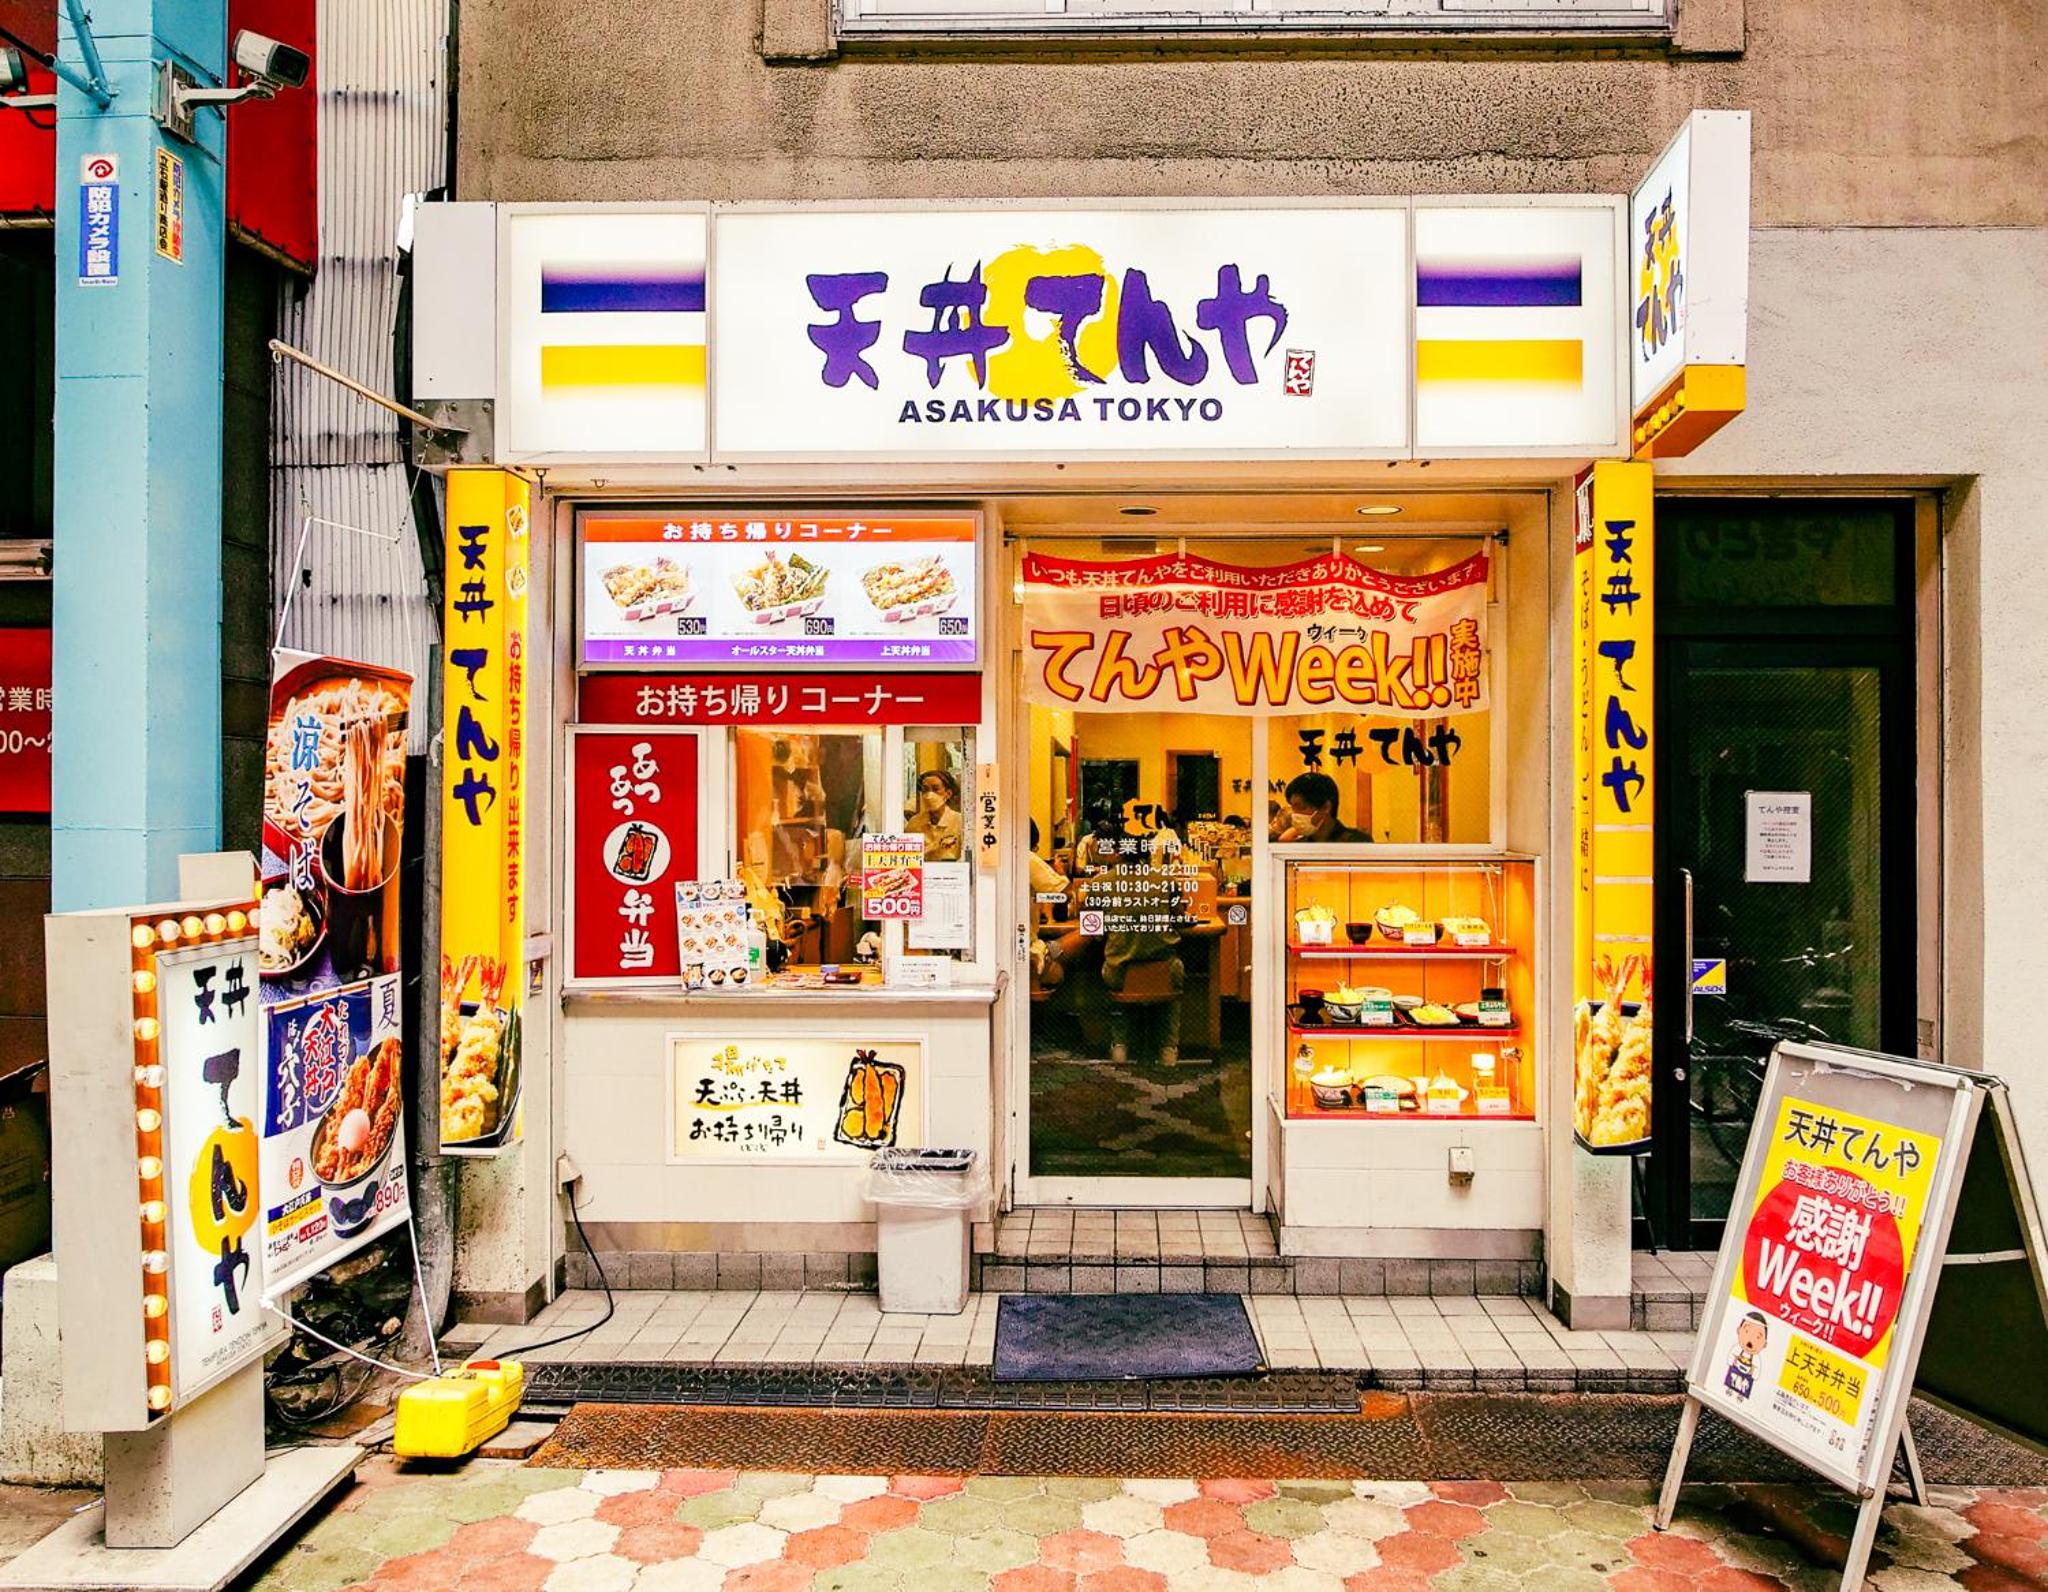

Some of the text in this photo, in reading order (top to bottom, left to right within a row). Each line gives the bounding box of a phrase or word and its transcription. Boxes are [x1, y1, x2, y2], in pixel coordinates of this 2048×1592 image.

[806, 260, 1289, 391] 天丼てんや
[898, 398, 1224, 423] ASAKUSA TOKYO
[662, 522, 894, 541] お持ち帰りコーナー
[1099, 586, 1421, 624] 日頃のご利用に感謝を込めて
[450, 525, 499, 826] 天丼てんや
[1450, 617, 1482, 708] 実施中
[1598, 520, 1648, 812] 天丼てんや
[636, 684, 925, 717] お持ち帰りコーナー
[1298, 724, 1462, 767] 天丼てんや
[1097, 838, 1182, 855] 営業時間
[866, 897, 921, 915] 500円
[1079, 881, 1113, 893] 土日祝
[618, 888, 656, 969] 弁当
[193, 955, 250, 1025] 天丼
[377, 979, 399, 1031] 夏
[689, 1115, 803, 1147] お持ち帰り
[1784, 1109, 1921, 1179] 天丼てんや
[1785, 1193, 1872, 1273] 感謝
[1757, 1239, 1884, 1341] Week!!
[1785, 1346, 1861, 1400] 上天丼弁当
